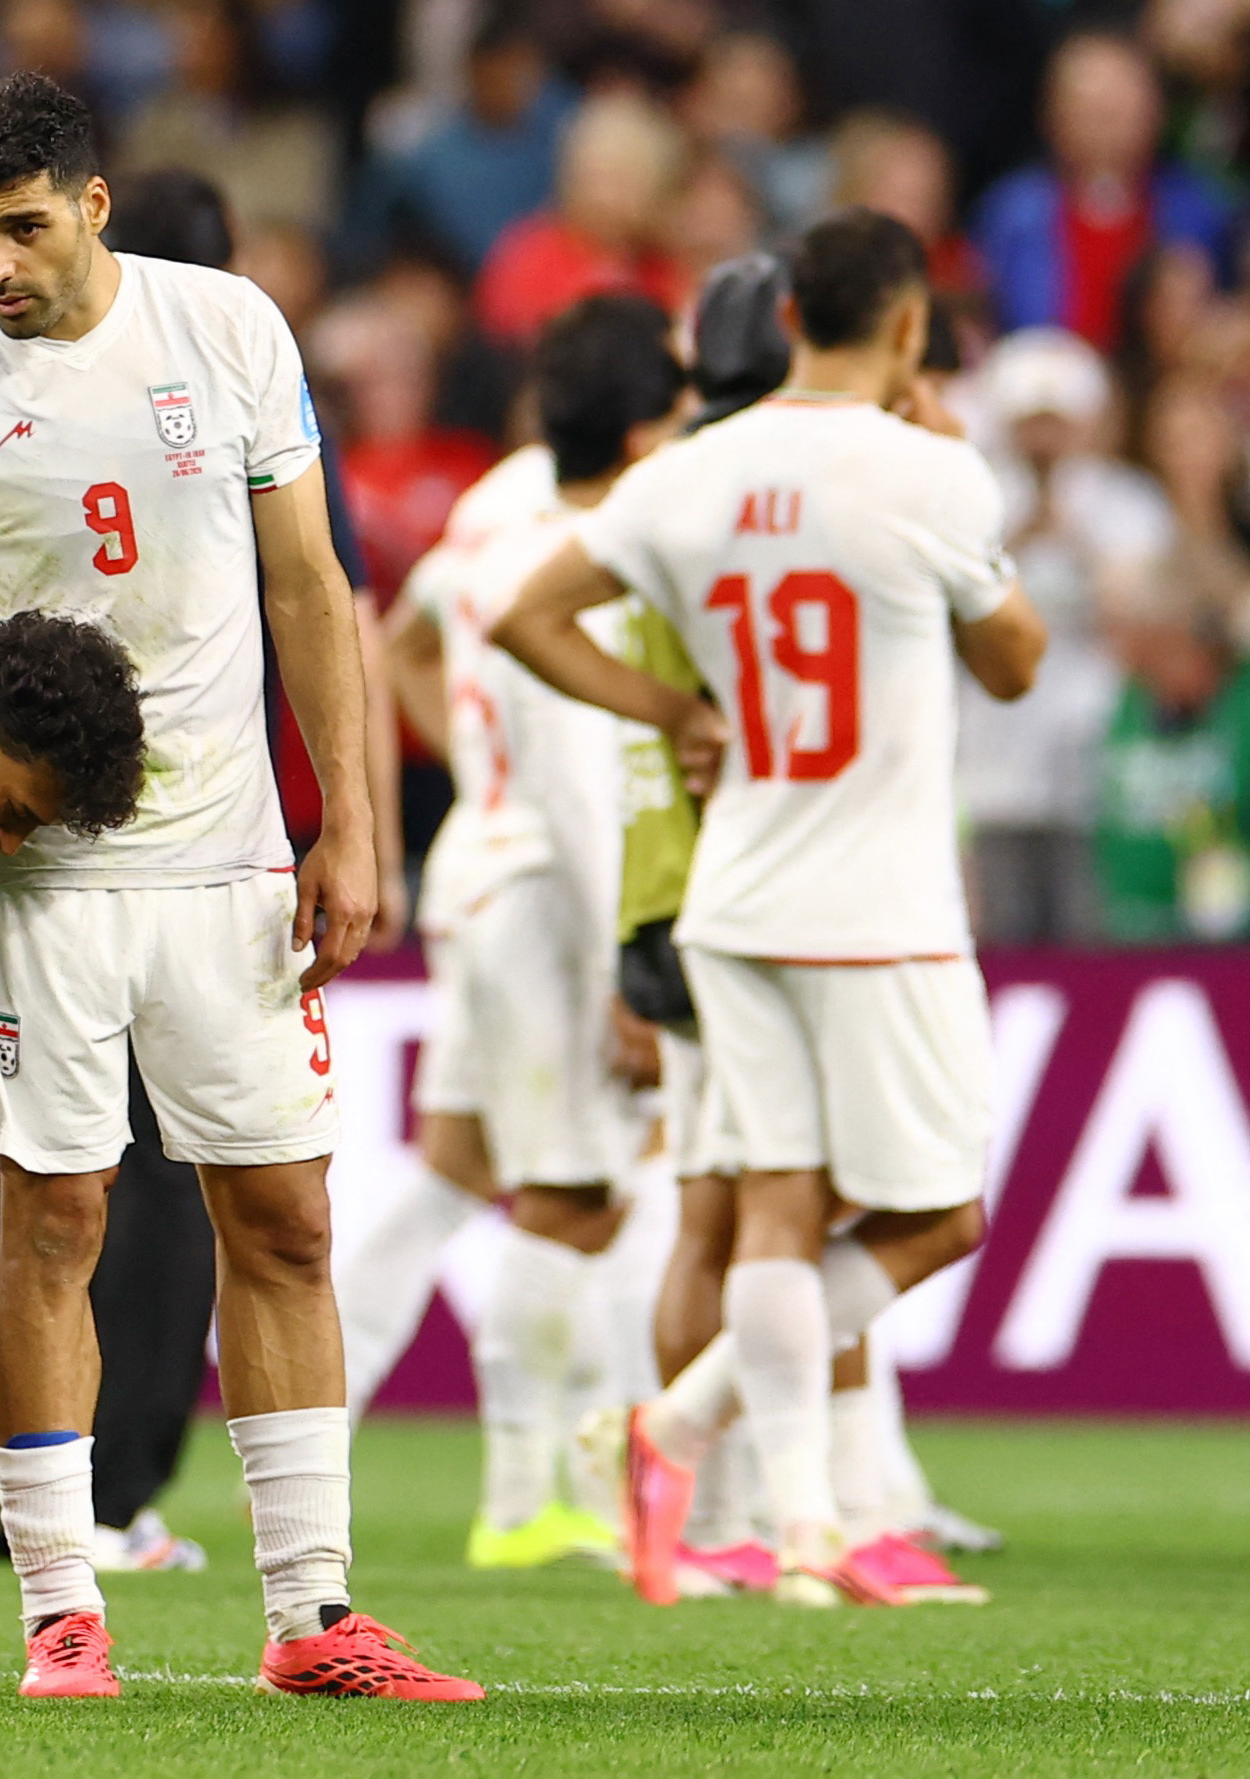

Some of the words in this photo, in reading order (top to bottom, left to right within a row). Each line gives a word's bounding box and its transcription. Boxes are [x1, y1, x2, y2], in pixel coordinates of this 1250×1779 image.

[82, 481, 139, 577] 9
[733, 487, 802, 535] ALI
[703, 569, 860, 782] 19
[300, 985, 331, 1076] 9
